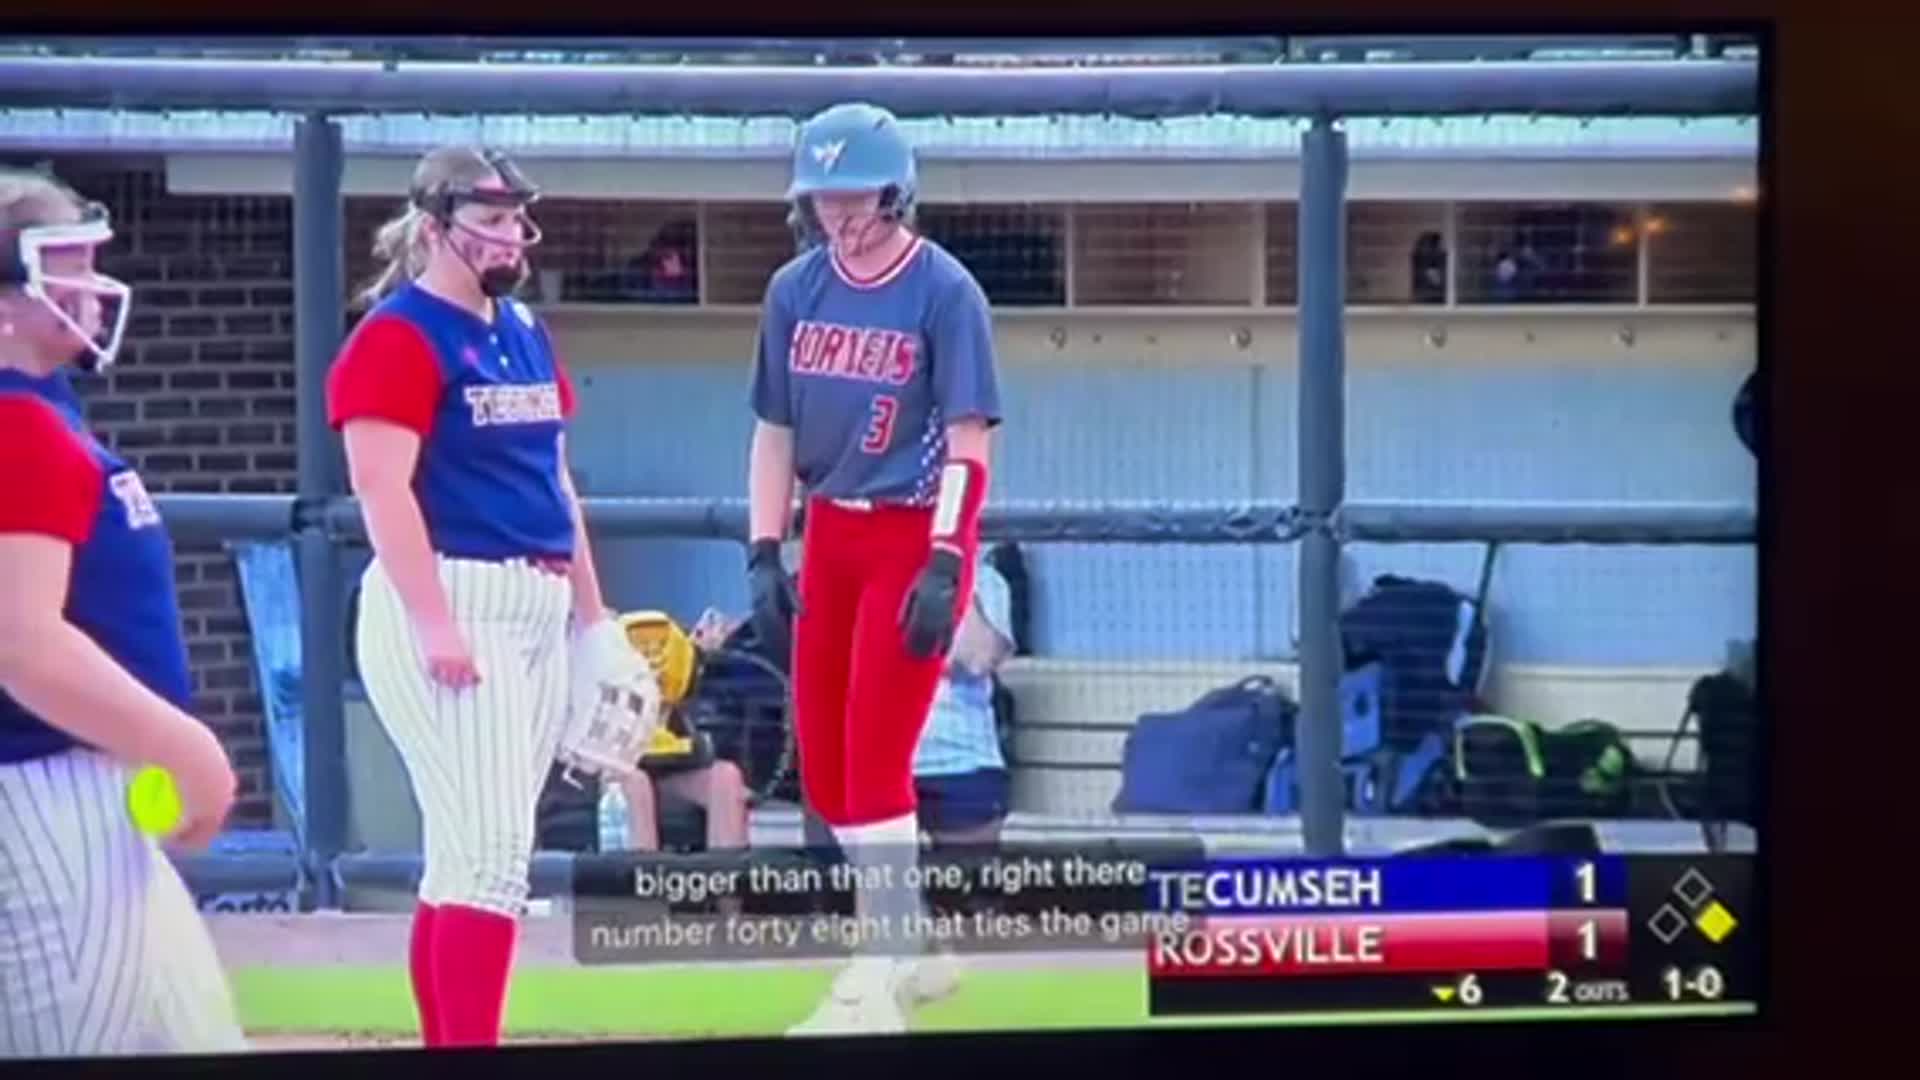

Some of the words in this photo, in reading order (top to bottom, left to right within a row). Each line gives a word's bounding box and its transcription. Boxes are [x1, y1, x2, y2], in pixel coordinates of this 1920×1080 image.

[861, 394, 898, 454] 3
[635, 866, 737, 901] bigger
[752, 865, 822, 892] than
[830, 863, 893, 889] that
[904, 863, 972, 893] one,
[981, 857, 1055, 894] right
[1063, 856, 1146, 885] there
[1150, 868, 1382, 907] TECUMSEH
[1575, 862, 1595, 902] 1
[591, 917, 715, 948] number
[726, 914, 800, 946] forty
[811, 912, 891, 946] eight
[904, 909, 964, 938] that
[975, 908, 1032, 937] ties
[1040, 906, 1092, 935] the
[1101, 911, 1190, 941] game
[1156, 925, 1384, 966] ROSSVILLE
[1577, 919, 1597, 960] 1
[1458, 973, 1482, 1003] 6
[1547, 970, 1569, 1002] 2
[1664, 966, 1723, 998] 1-0
